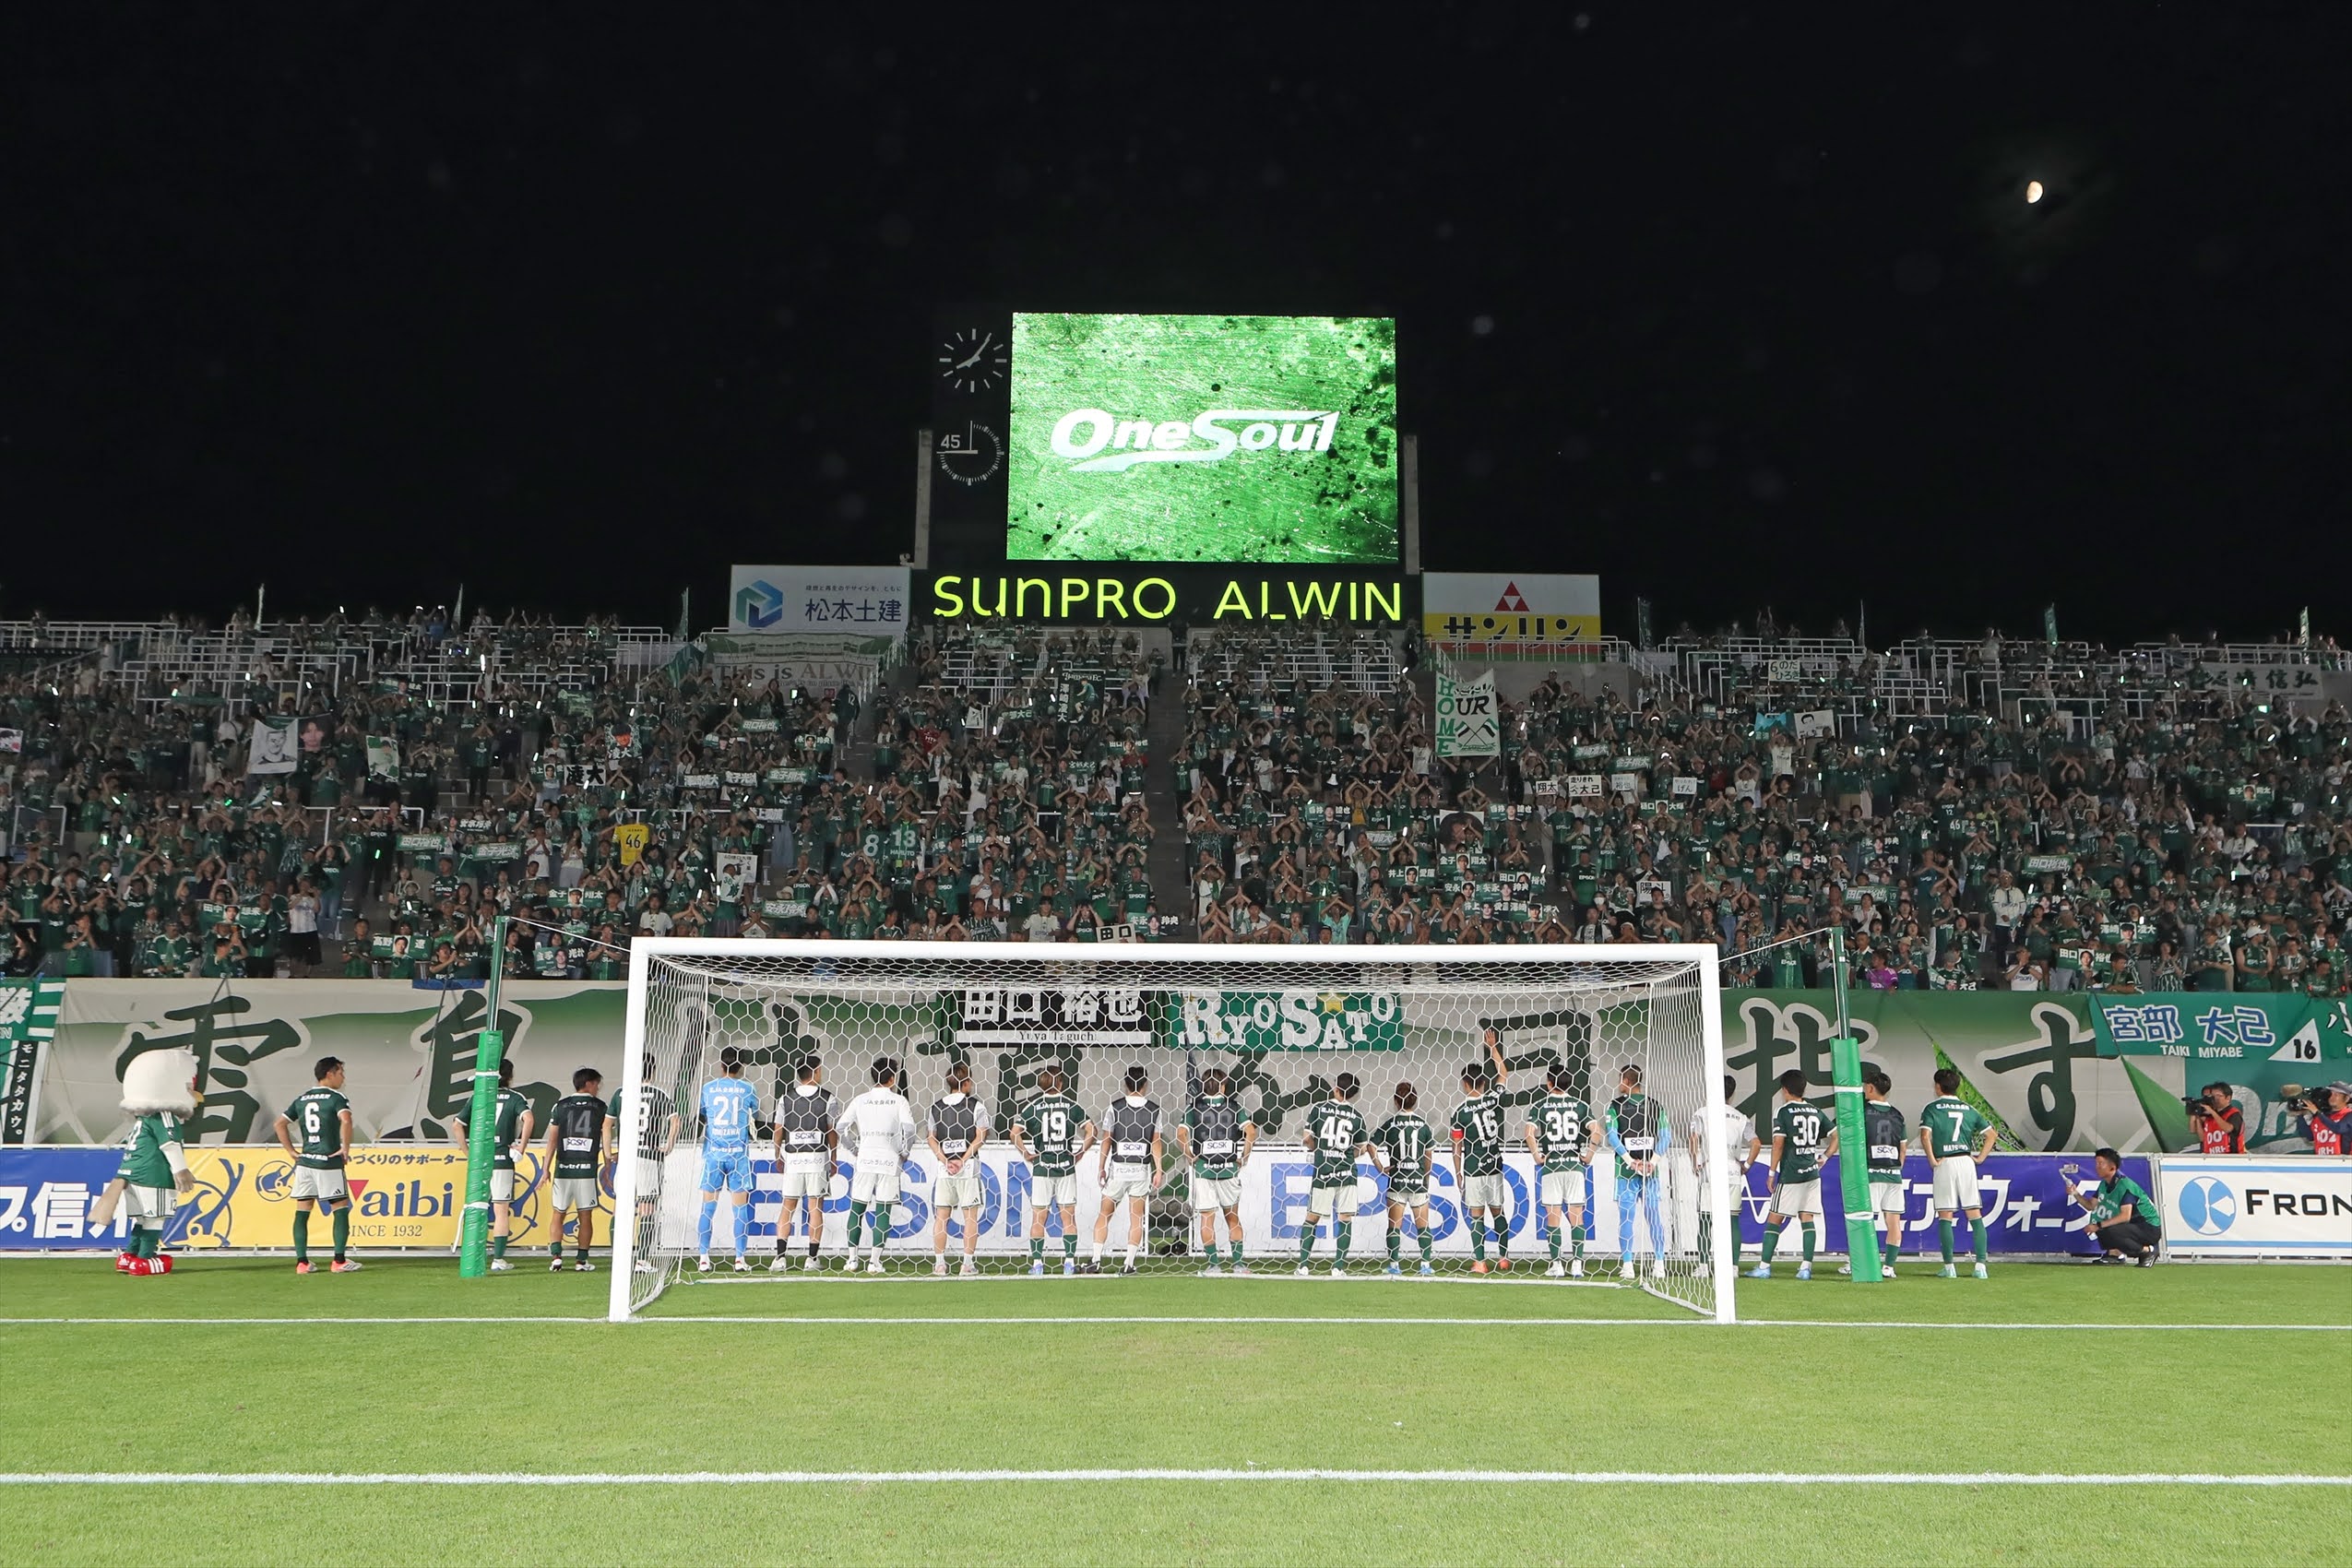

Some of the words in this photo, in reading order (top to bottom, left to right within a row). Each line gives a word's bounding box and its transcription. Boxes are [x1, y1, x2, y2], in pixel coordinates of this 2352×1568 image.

[941, 434, 961, 449] 45
[1213, 580, 1401, 621] ALWIN
[805, 598, 902, 622] 松本土建
[1443, 616, 1583, 649] サンリン
[848, 693, 857, 707] 12
[1090, 708, 1100, 725] 8
[1436, 677, 1456, 755] HOME
[1537, 782, 1557, 793] 翔太
[1949, 819, 1961, 831] 46
[625, 834, 641, 849] 46
[863, 834, 880, 857] 8
[892, 829, 916, 847] 13
[1440, 856, 1456, 865] 金子
[1470, 856, 1488, 865] 翔太
[1388, 869, 1405, 878] 井上
[1499, 873, 1515, 882] 田口
[548, 888, 567, 898] 金子
[1444, 883, 1461, 892] 安永
[203, 904, 223, 913] 田中
[1099, 927, 1133, 941] 田口
[2059, 947, 2078, 959] 田口
[964, 990, 1041, 1023] 田口
[1060, 990, 1143, 1023] 裕也
[2104, 1004, 2184, 1044] 宮部
[2195, 1005, 2276, 1047] 大己
[2159, 1044, 2191, 1057] TAIKI
[2198, 1045, 2244, 1059] MIYABE
[2293, 1039, 2317, 1060] 16
[304, 1103, 319, 1134] 6
[714, 1096, 740, 1126] 21
[1041, 1111, 1067, 1143] 19
[1321, 1116, 1353, 1151] 46
[1474, 1111, 1498, 1143] 16
[1546, 1110, 1579, 1142] 36
[1793, 1114, 1821, 1146] 30
[1948, 1111, 1964, 1142] 7
[567, 1138, 587, 1146] SCSK
[795, 1132, 815, 1140] SCSK
[1398, 1129, 1420, 1160] 11
[1044, 1144, 1064, 1152] TANAKA
[1123, 1143, 1143, 1151] SCSK
[1206, 1141, 1227, 1149] SCSK
[318, 1180, 454, 1218] aibi
[2246, 1189, 2352, 1217] FRON
[393, 1224, 422, 1237] 1932
